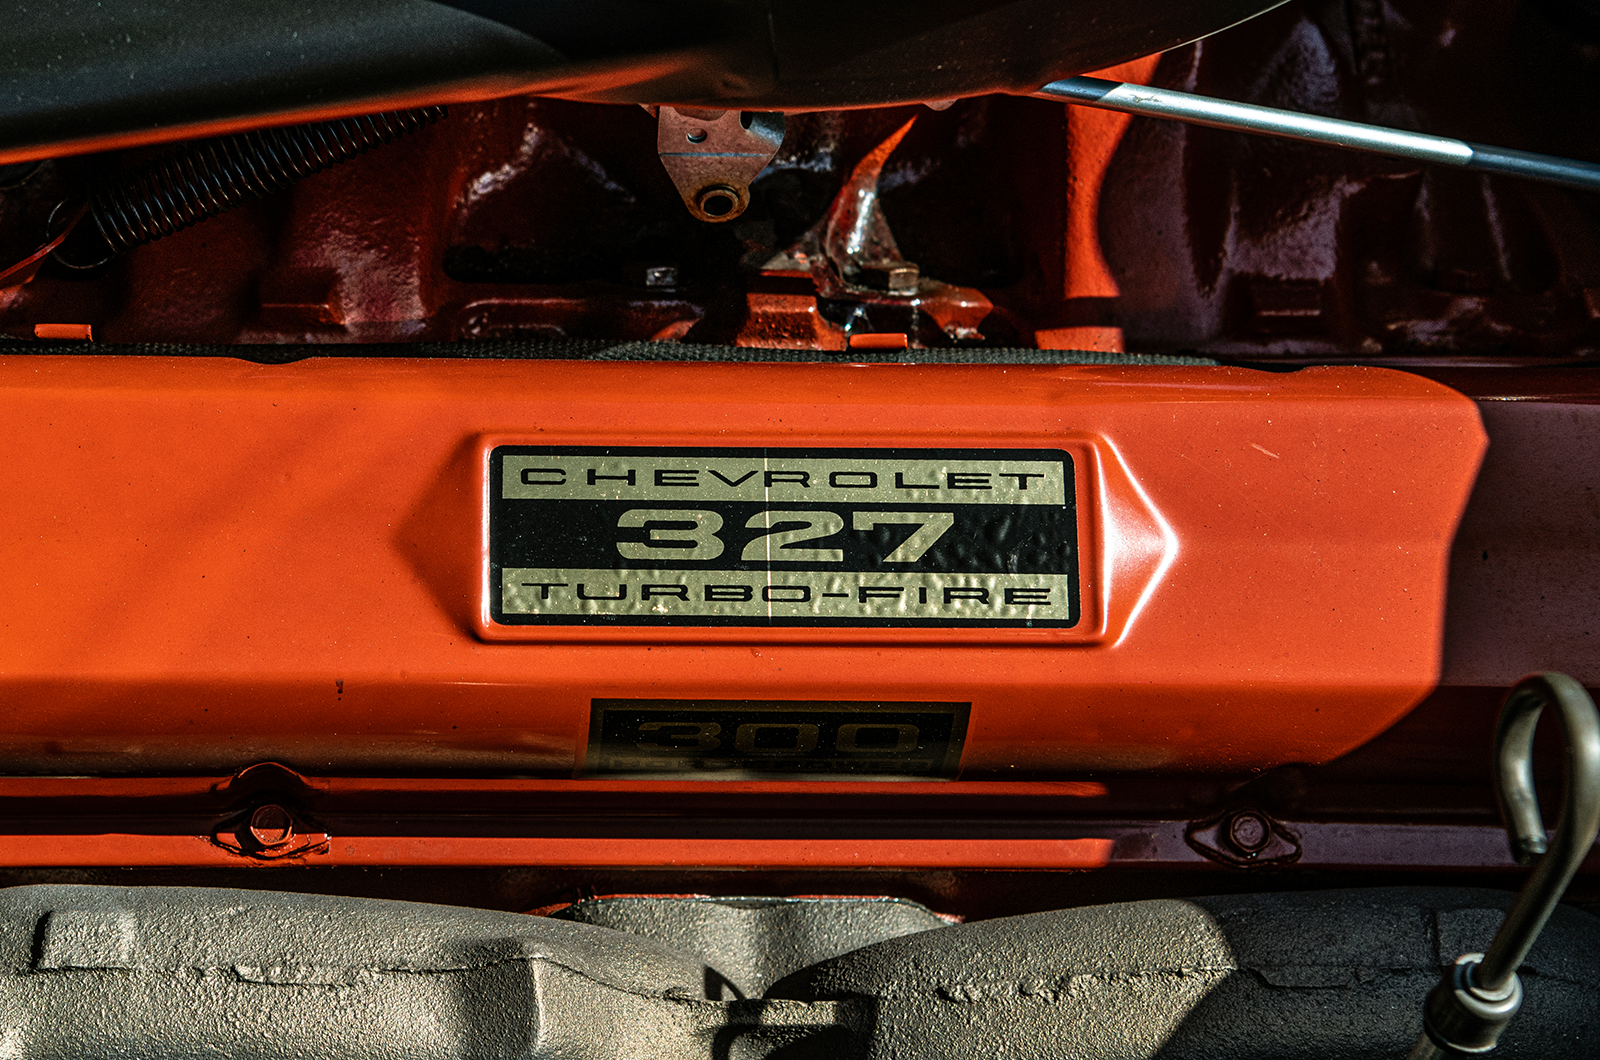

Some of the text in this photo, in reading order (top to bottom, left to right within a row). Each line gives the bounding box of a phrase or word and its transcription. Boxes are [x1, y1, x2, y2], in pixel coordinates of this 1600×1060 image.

[520, 468, 1045, 491] CHEVROLET
[616, 508, 954, 563] 327
[521, 582, 1052, 606] TURBO-FIRE
[637, 721, 920, 752] 300
